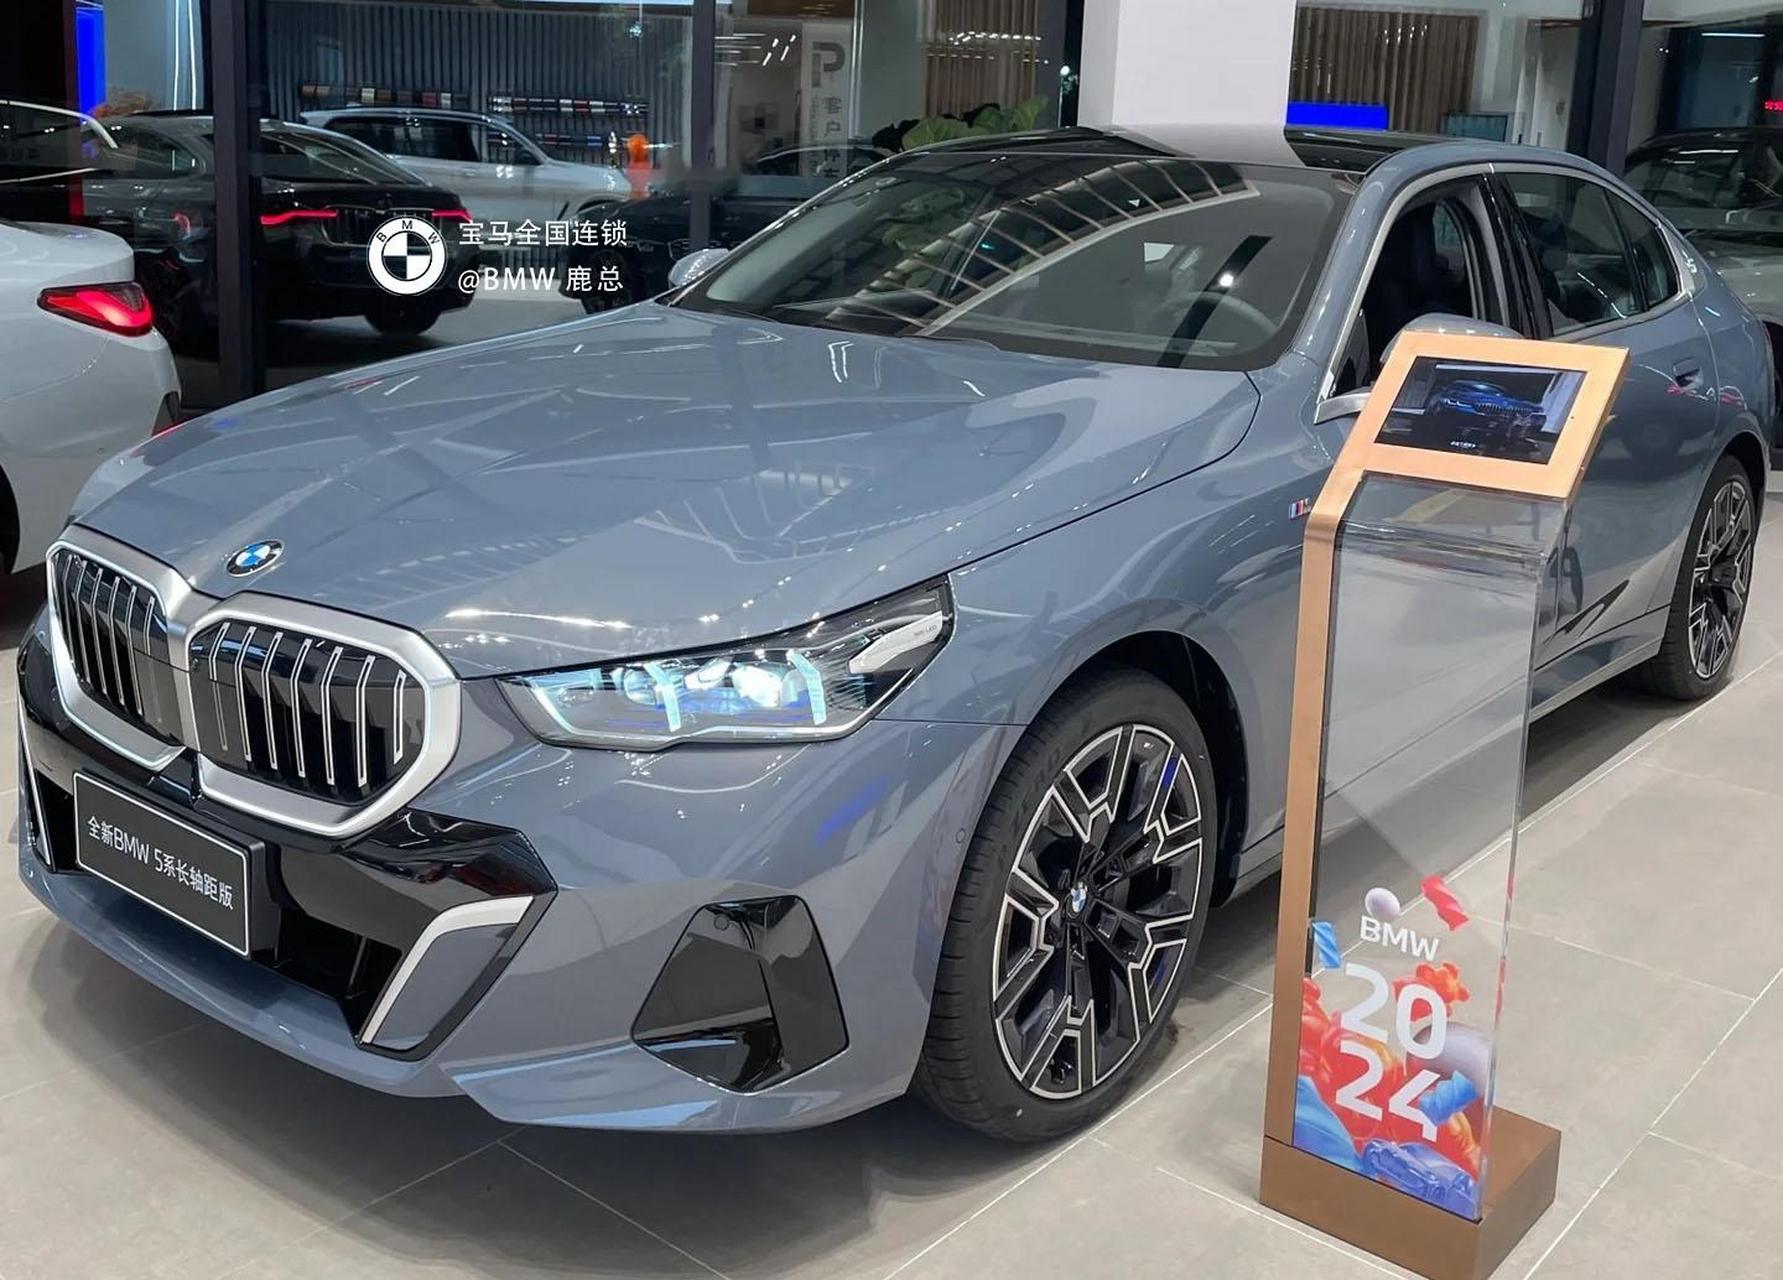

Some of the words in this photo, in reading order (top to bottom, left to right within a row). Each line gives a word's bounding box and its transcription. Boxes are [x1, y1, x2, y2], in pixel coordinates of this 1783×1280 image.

[87, 815, 150, 865] 全新BMW
[154, 848, 234, 911] 5系长轴距版
[1360, 915, 1440, 962] BMW
[1340, 962, 1448, 1060] 20
